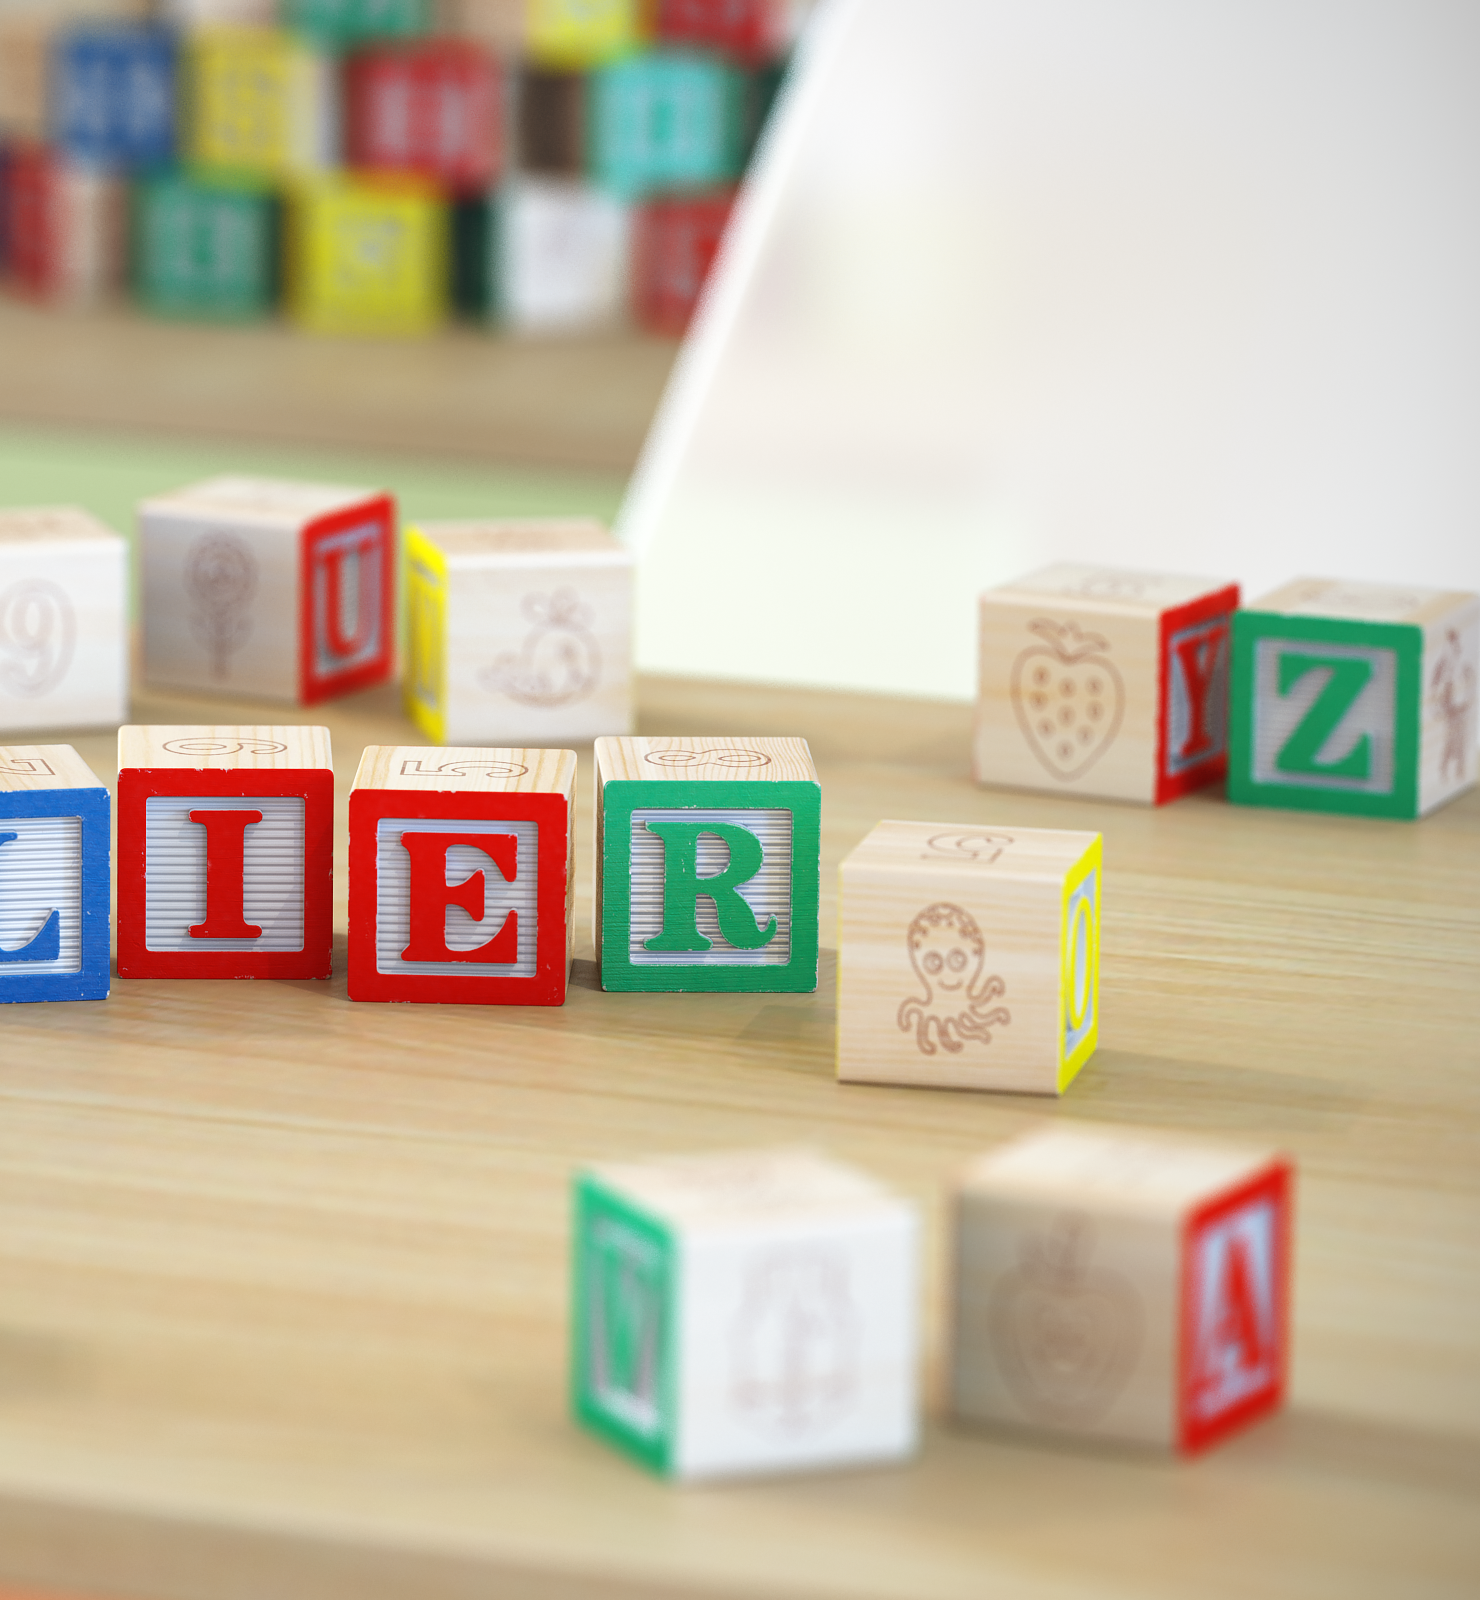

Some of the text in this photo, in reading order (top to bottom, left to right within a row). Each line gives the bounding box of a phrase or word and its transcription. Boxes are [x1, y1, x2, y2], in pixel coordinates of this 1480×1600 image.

[318, 536, 379, 658] U
[1176, 628, 1229, 758] Y
[1277, 651, 1375, 781] Z
[401, 760, 528, 779] 5
[644, 748, 772, 767] 8
[1192, 1236, 1275, 1393] A
